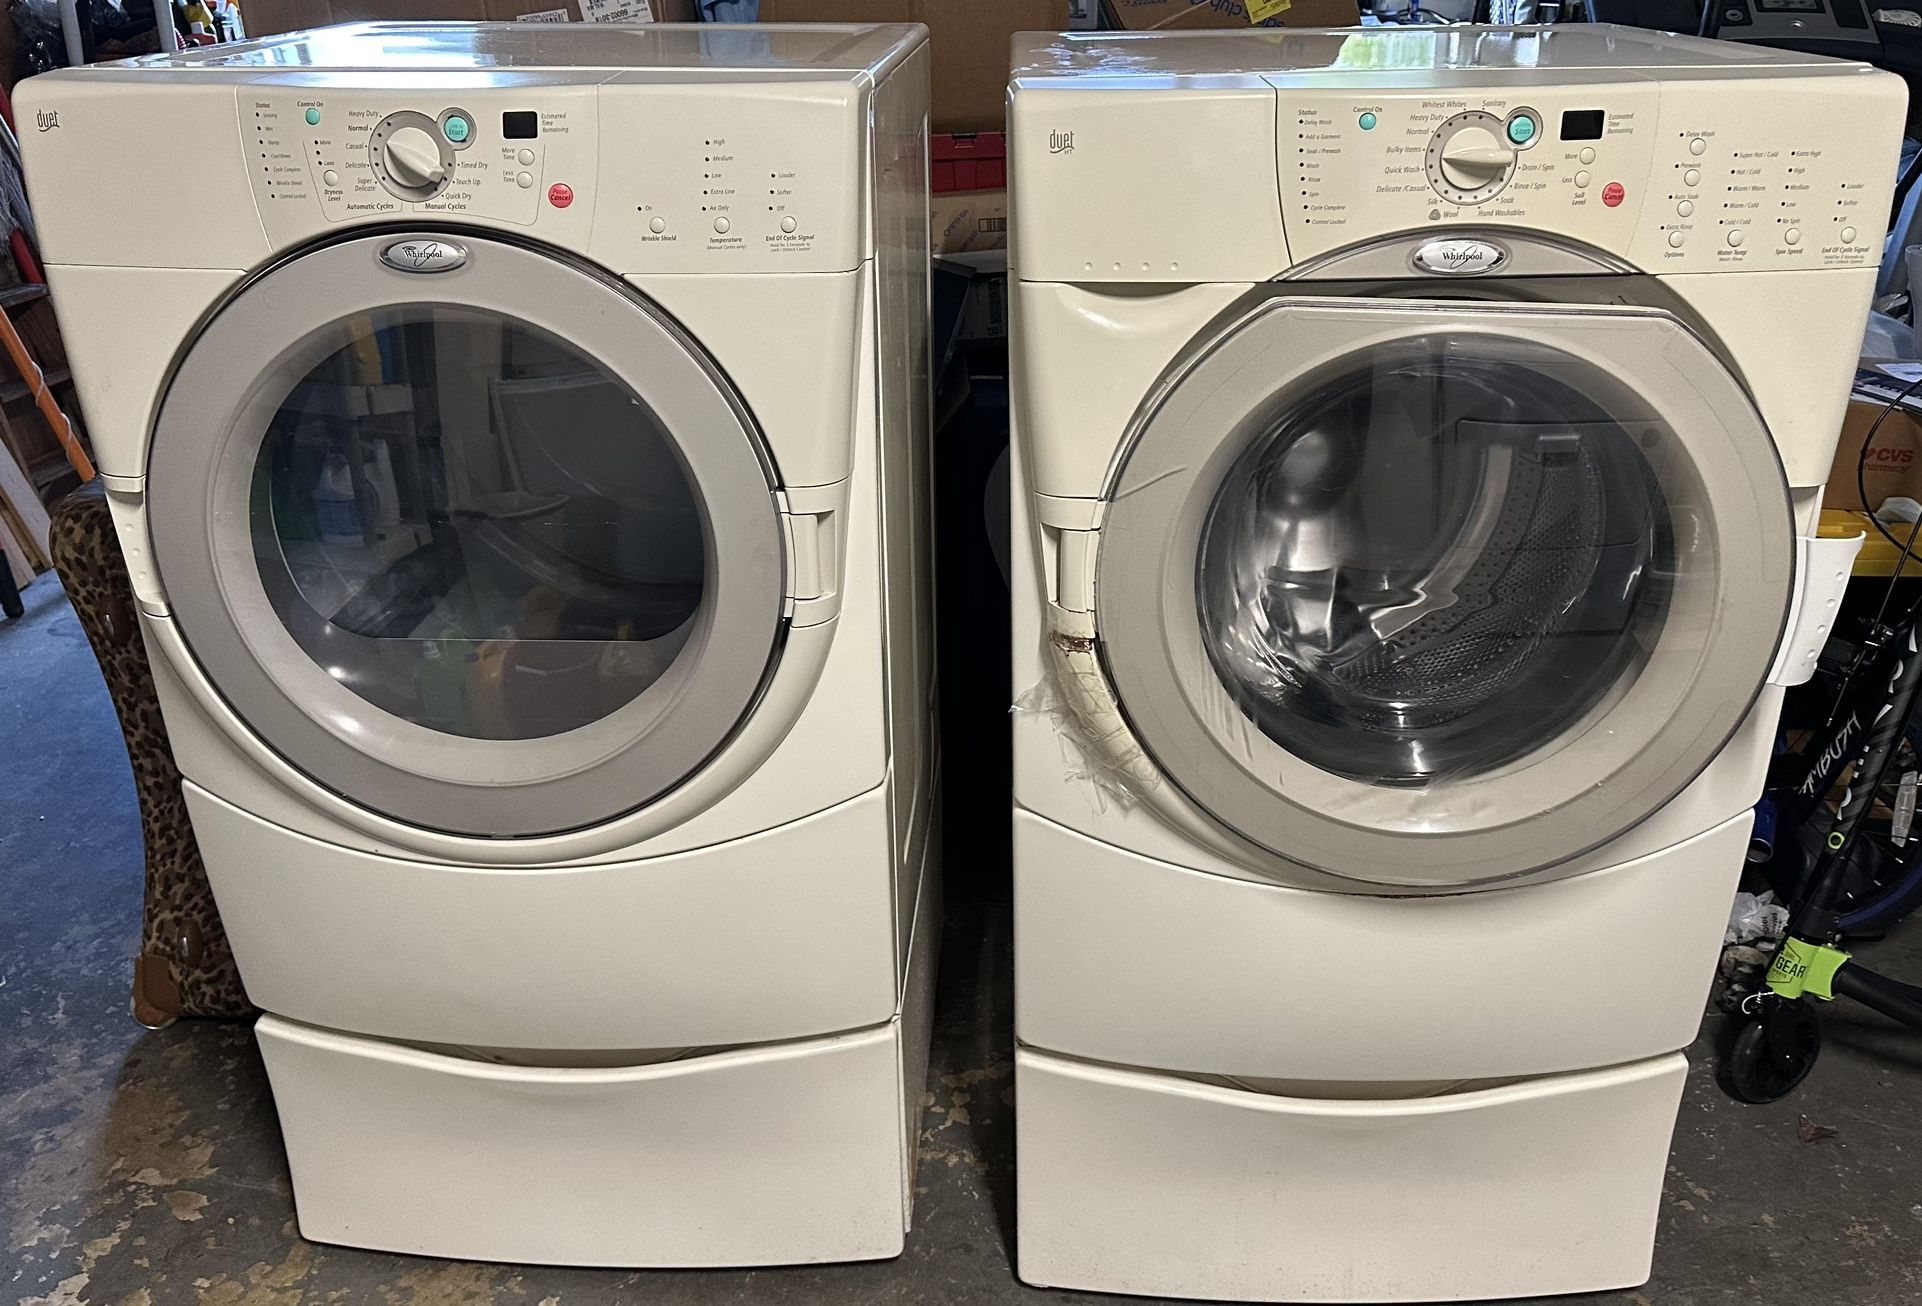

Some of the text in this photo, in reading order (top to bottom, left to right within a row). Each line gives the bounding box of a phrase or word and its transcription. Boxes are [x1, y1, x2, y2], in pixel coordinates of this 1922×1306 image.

[1210, 0, 1242, 16] club
[37, 109, 60, 131] duet
[1050, 129, 1074, 149] duet
[404, 250, 442, 258] Whirlpool
[1442, 252, 1483, 260] Whirlpool
[1877, 448, 1914, 463] CVS
[1775, 954, 1807, 978] GEAR
